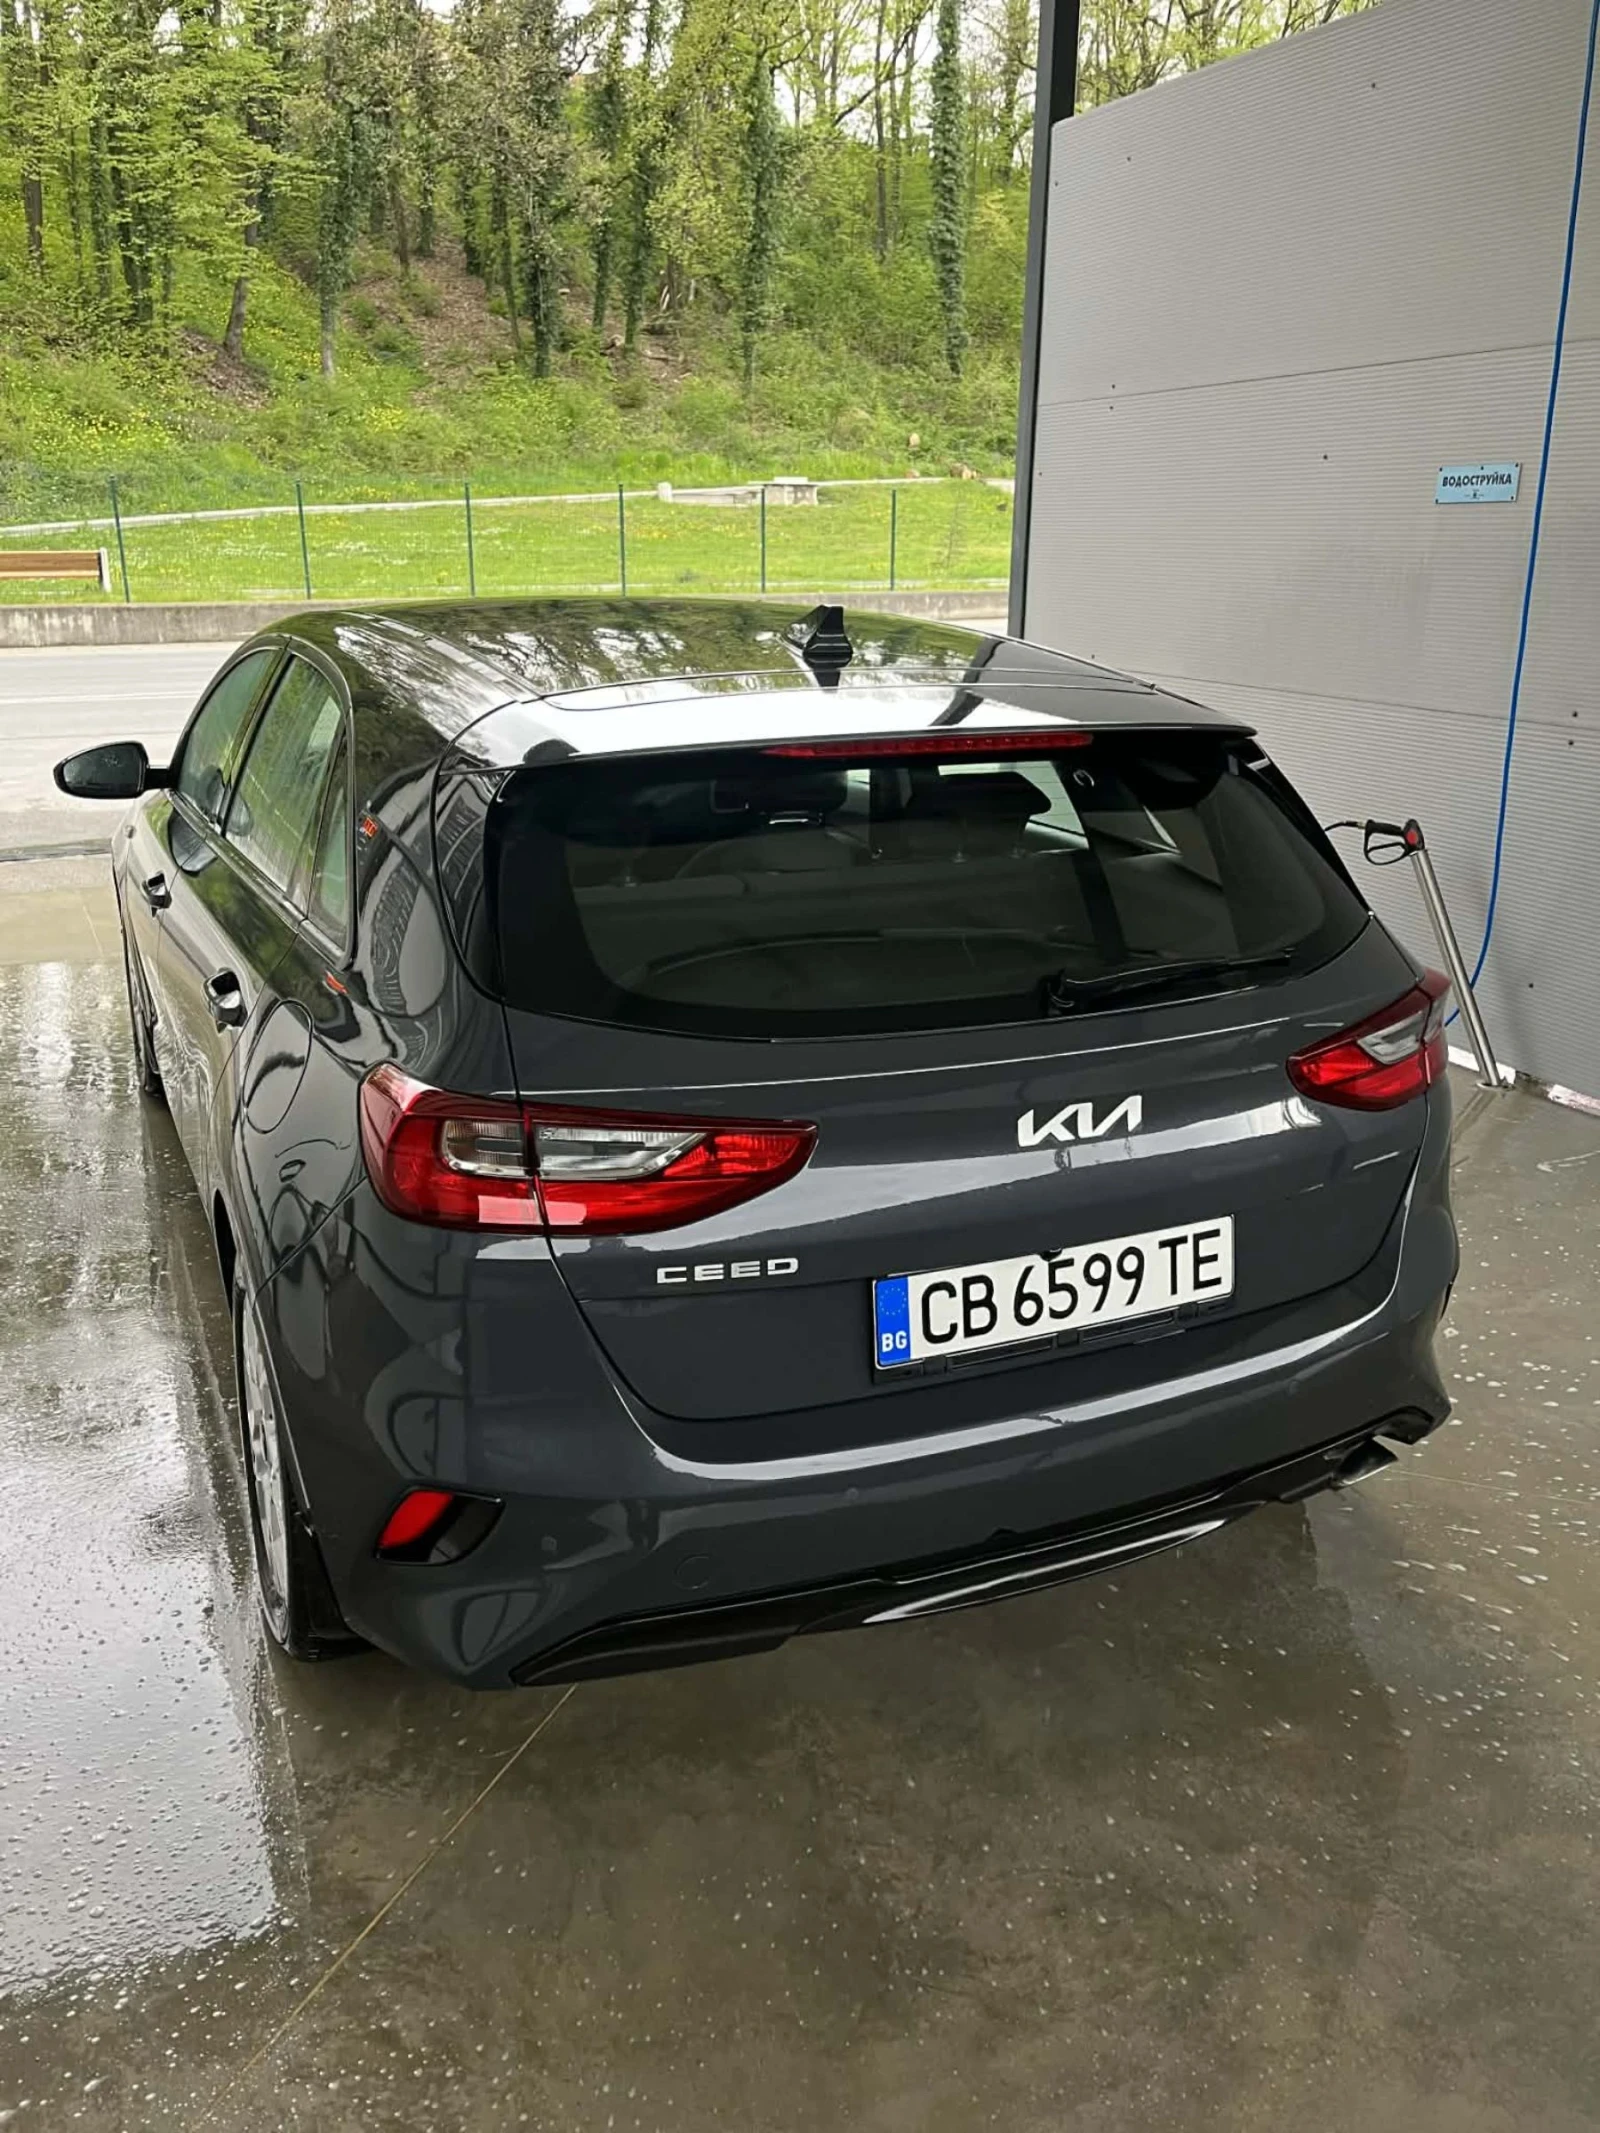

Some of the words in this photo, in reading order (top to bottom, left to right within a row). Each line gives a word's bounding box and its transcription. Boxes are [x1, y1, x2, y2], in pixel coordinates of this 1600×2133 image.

[1442, 472, 1512, 488] ВОДОСТРУЙКА
[1017, 1094, 1142, 1148] KIA
[656, 1257, 799, 1284] CEED
[921, 1274, 998, 1344] CB
[1013, 1246, 1145, 1327] 6599
[1158, 1228, 1222, 1296] TE
[881, 1330, 908, 1353] BG
